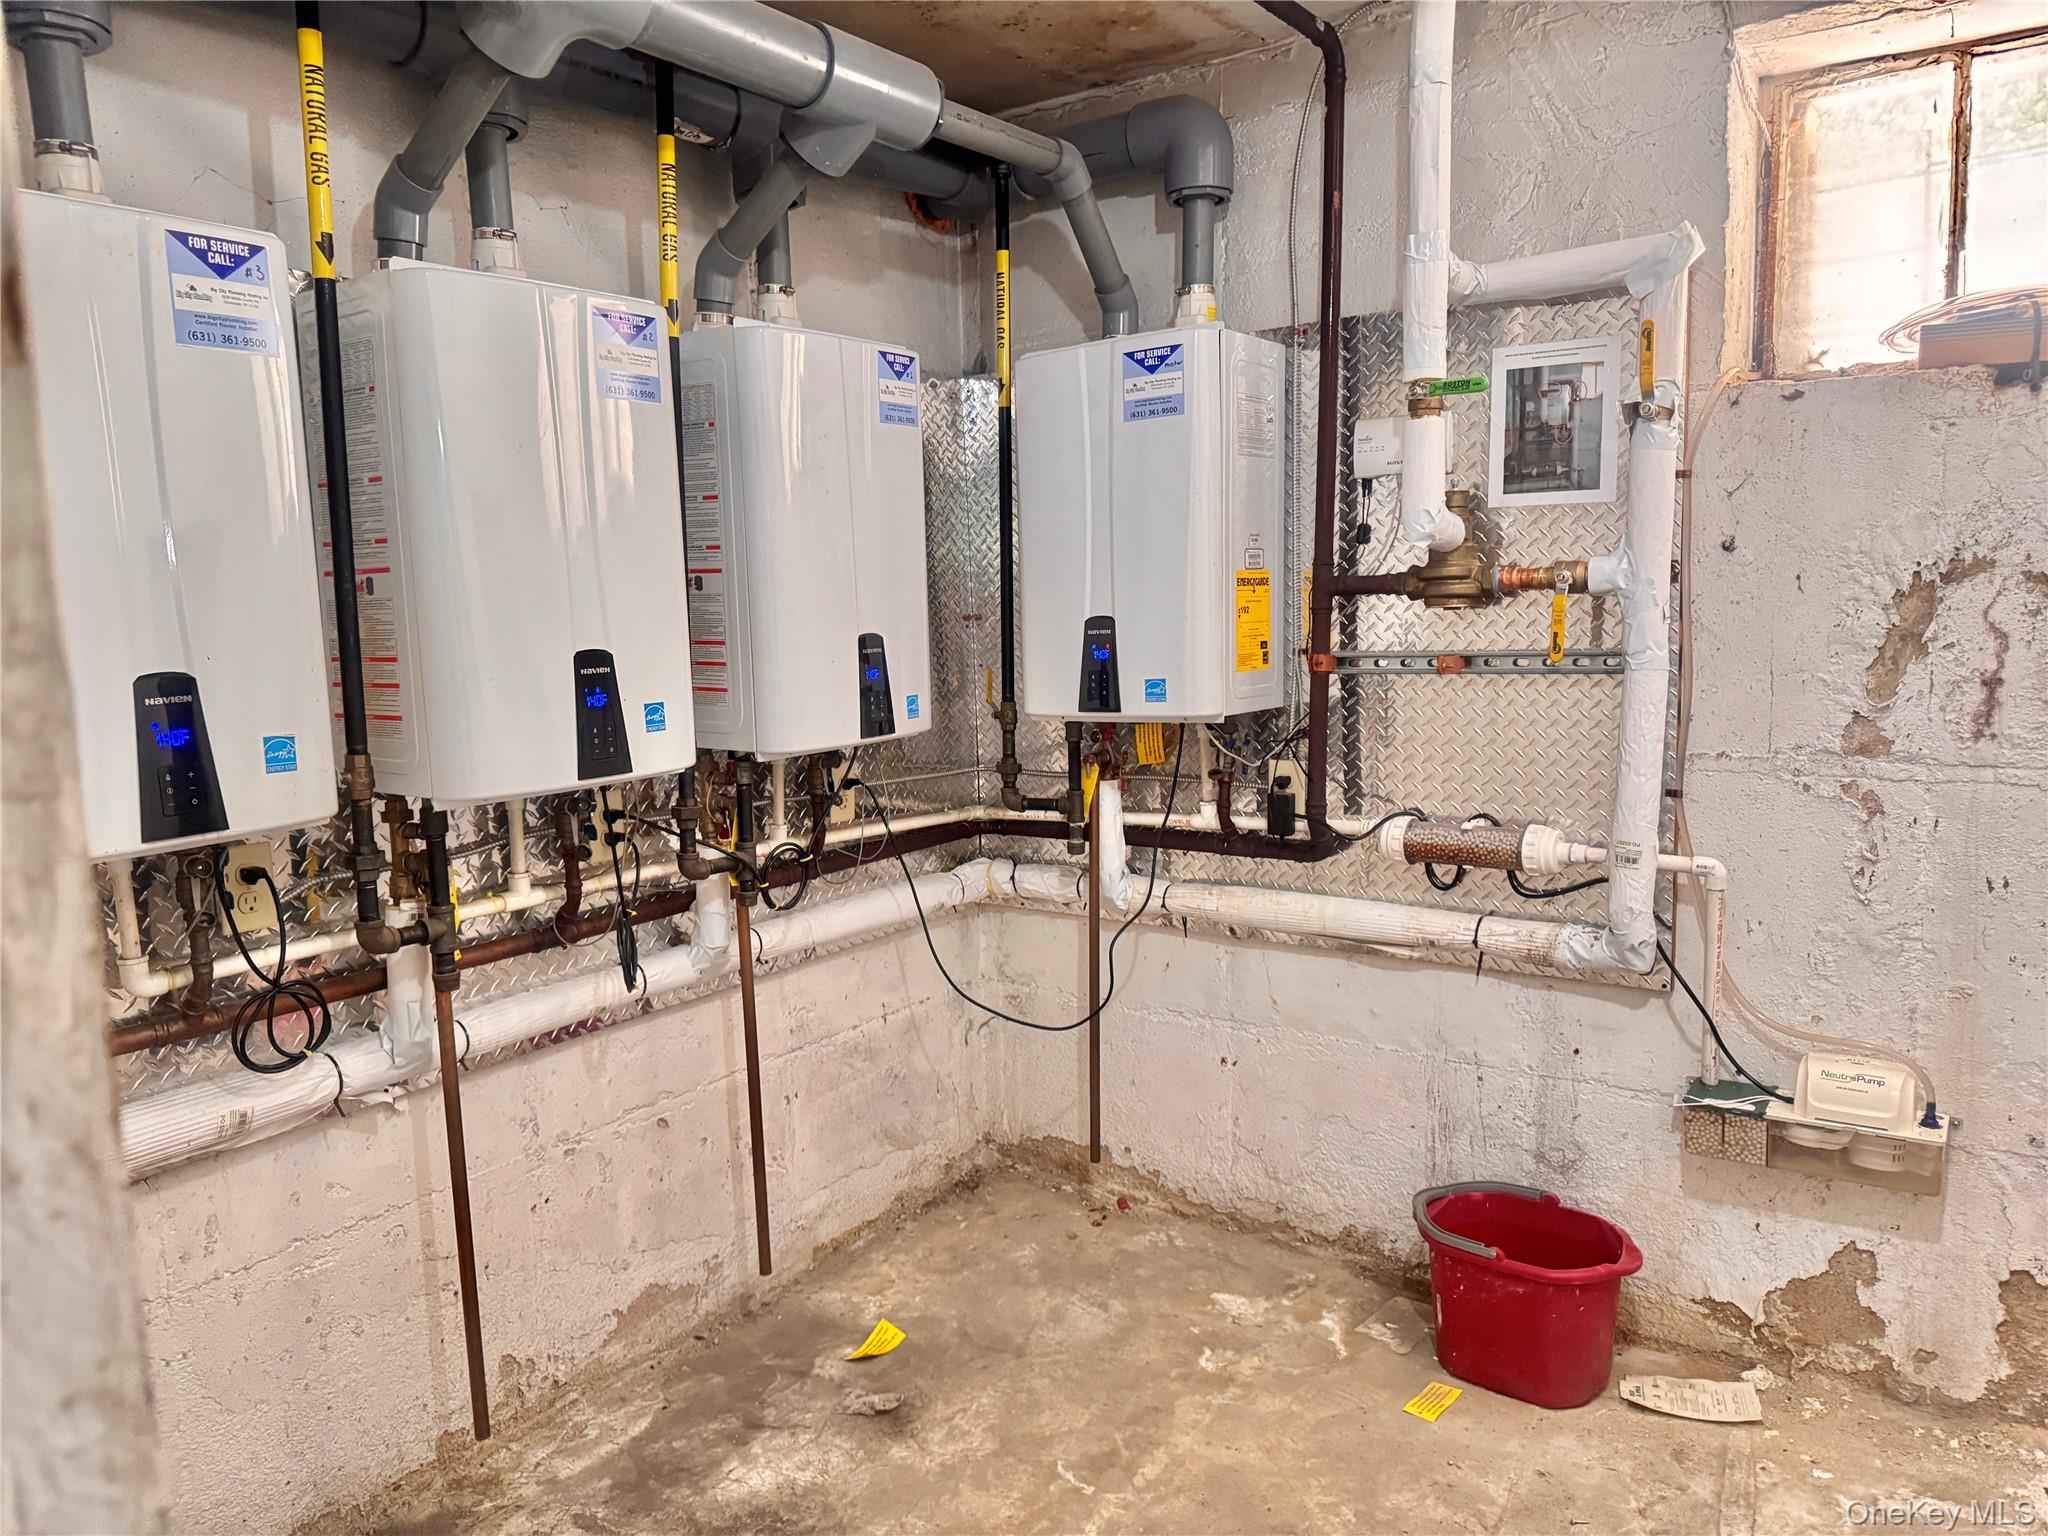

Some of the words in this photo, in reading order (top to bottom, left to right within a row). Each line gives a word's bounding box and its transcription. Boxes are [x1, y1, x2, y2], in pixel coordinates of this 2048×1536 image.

[304, 63, 327, 145] NATURAL
[310, 151, 330, 187] GAS
[661, 163, 678, 229] NATURAL
[188, 236, 208, 250] FOR
[210, 240, 250, 257] SERVICE
[662, 232, 678, 263] GAS
[207, 252, 235, 266] CALL:
[620, 315, 646, 327] SERVICE
[620, 323, 637, 334] CALL:
[187, 329, 217, 343] (631)
[220, 334, 267, 349] 361-9500
[895, 355, 910, 365] SERVICE
[1134, 352, 1145, 360] FOR
[1146, 347, 1171, 358] SERVICE
[1144, 357, 1161, 366] CALL:
[605, 385, 624, 396] (631)
[626, 387, 656, 399] 361-9500
[1129, 410, 1146, 419] (631)
[1148, 406, 1178, 416] 361-9500
